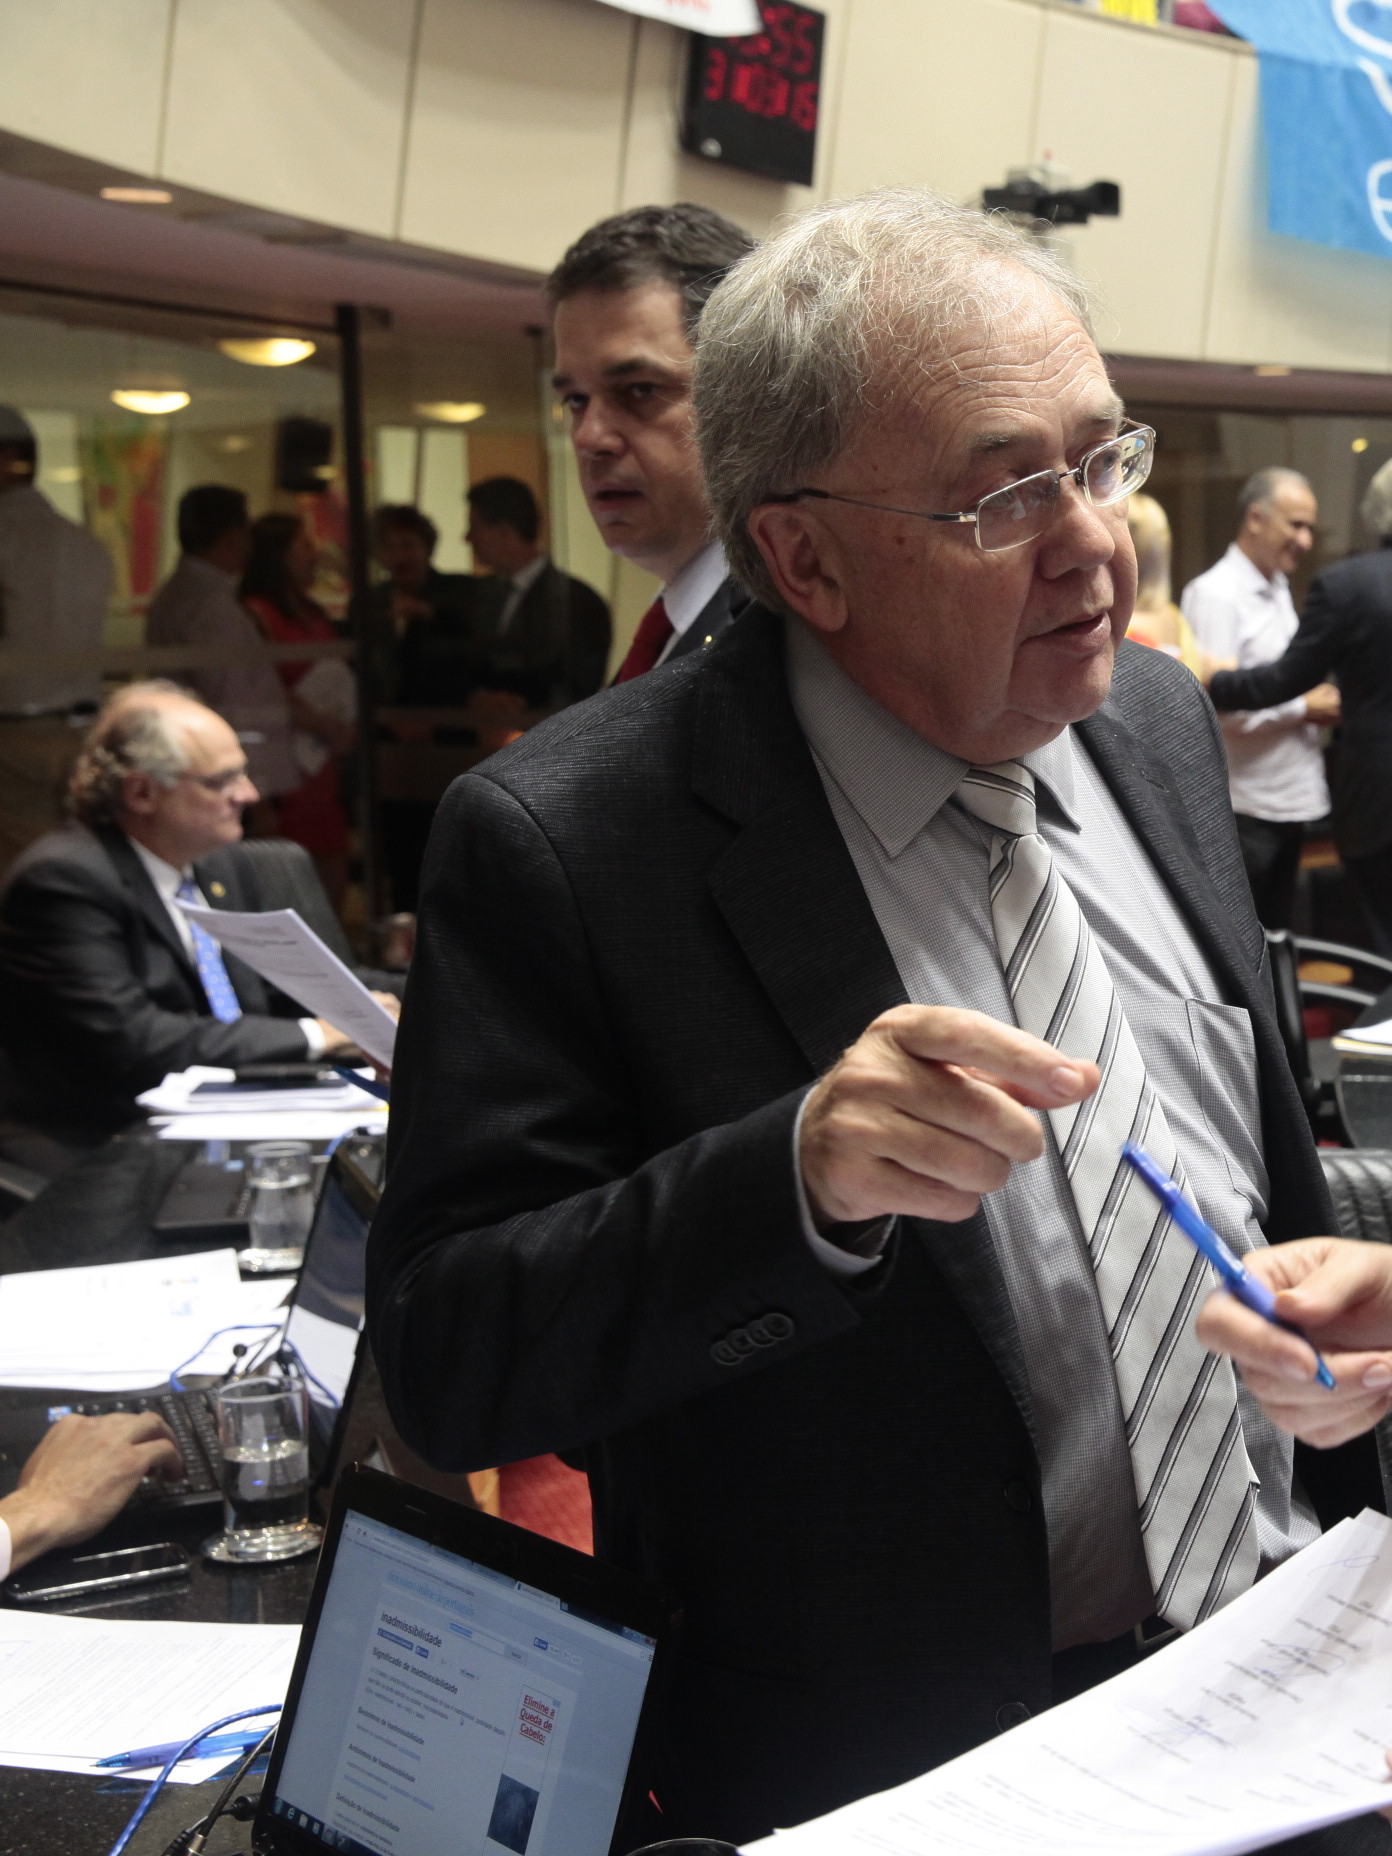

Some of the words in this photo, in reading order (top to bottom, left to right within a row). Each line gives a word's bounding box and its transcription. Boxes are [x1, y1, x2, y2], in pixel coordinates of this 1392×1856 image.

[381, 1611, 442, 1647] inadmissibilidade
[524, 1694, 549, 1714] Elimine
[550, 1709, 555, 1717] a
[520, 1708, 542, 1726] Queda
[543, 1720, 552, 1731] de
[520, 1723, 546, 1743] Cabelo:
